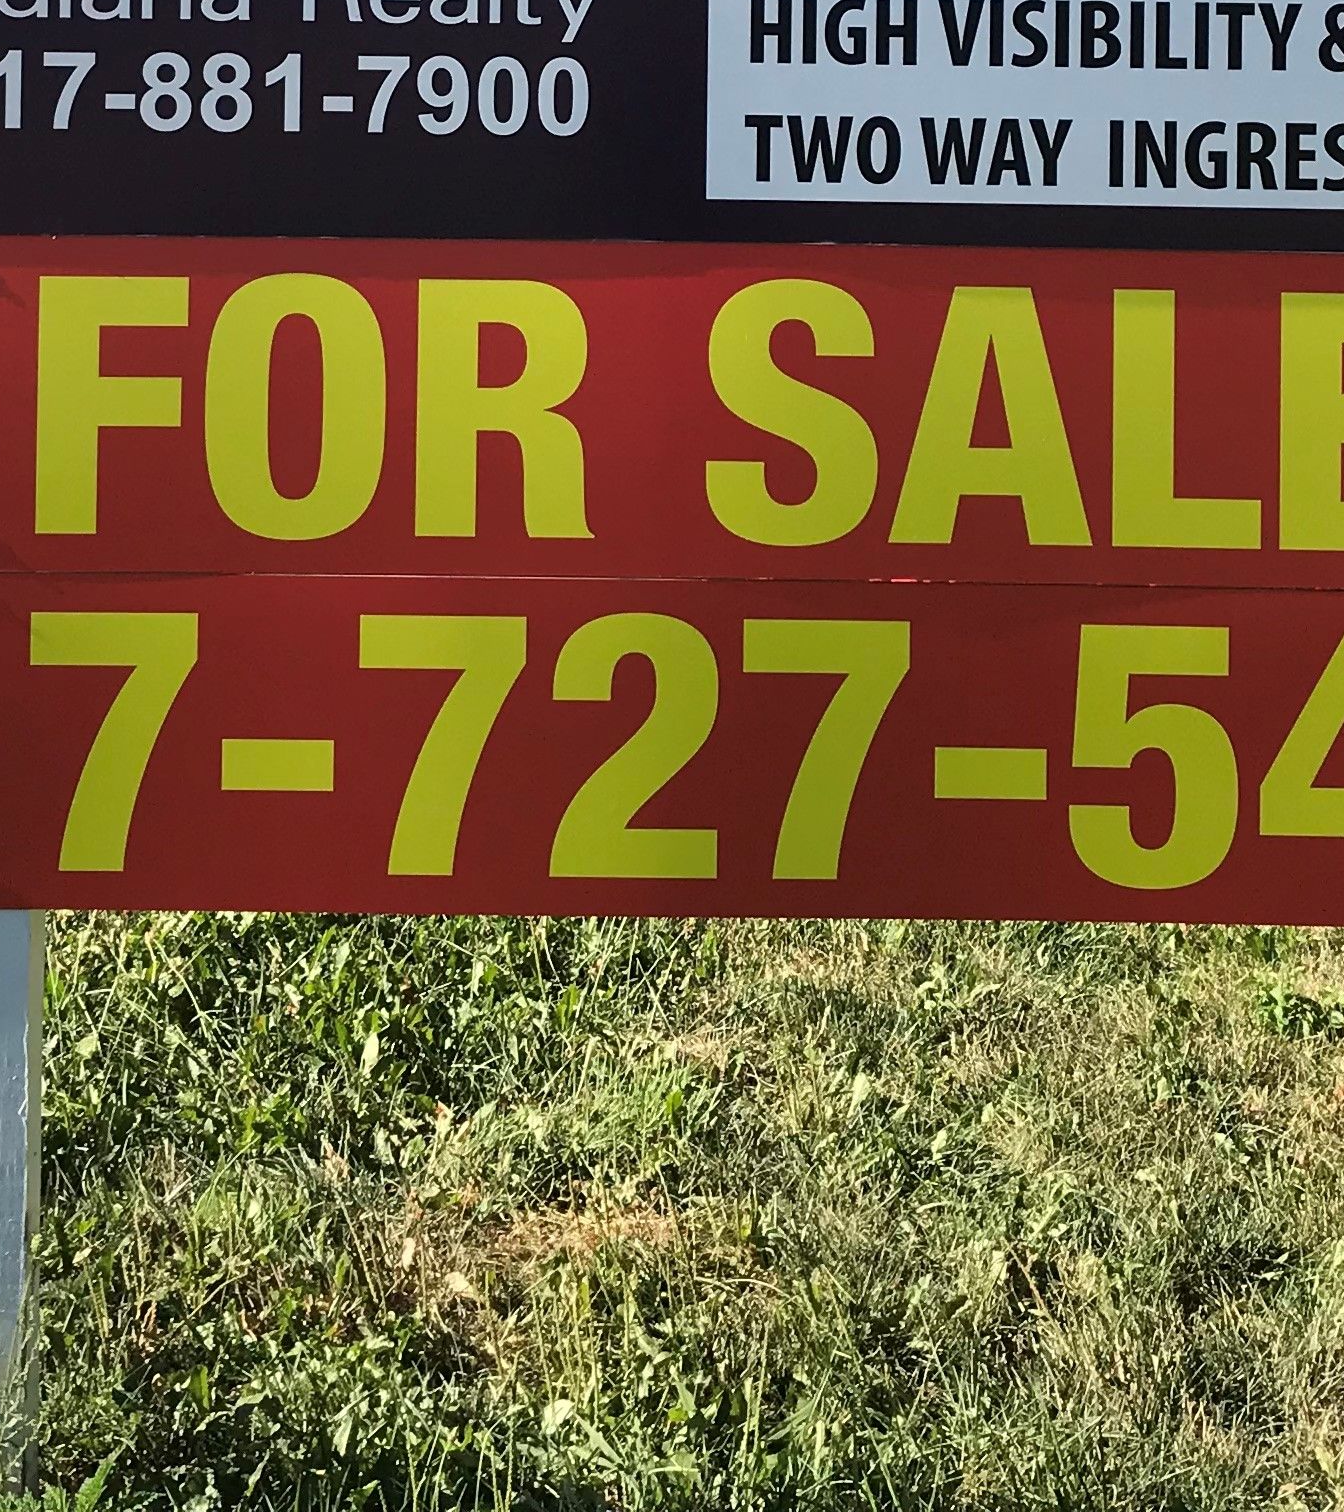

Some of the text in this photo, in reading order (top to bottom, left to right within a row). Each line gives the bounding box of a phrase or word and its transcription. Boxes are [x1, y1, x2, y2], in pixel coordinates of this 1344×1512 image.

[938, 0, 1302, 70] VISIBILITY
[745, 115, 901, 184] TWO
[920, 117, 1073, 186] WAY
[35, 273, 595, 540] FOR
